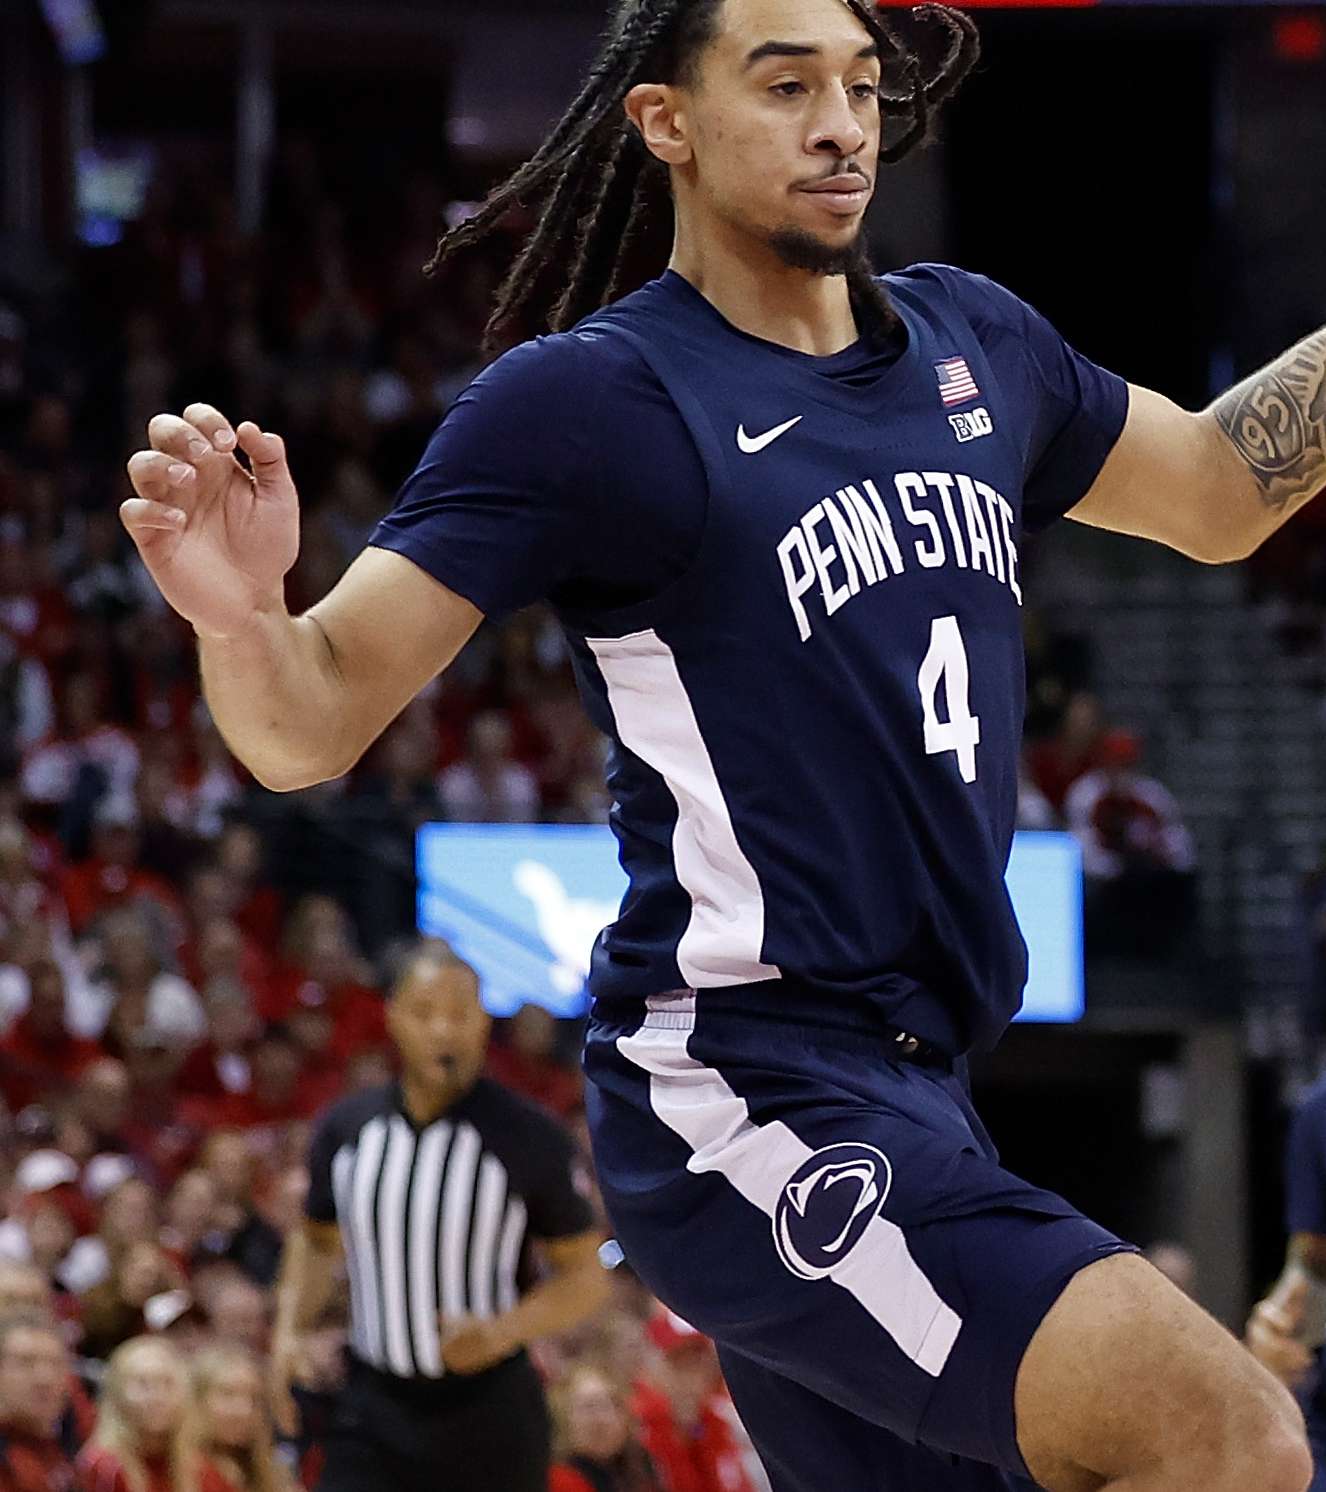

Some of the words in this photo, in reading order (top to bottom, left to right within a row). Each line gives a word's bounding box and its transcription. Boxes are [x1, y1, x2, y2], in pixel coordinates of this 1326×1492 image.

[776, 479, 905, 642] PENN
[893, 471, 1023, 606] STATE
[917, 615, 980, 783] 4
